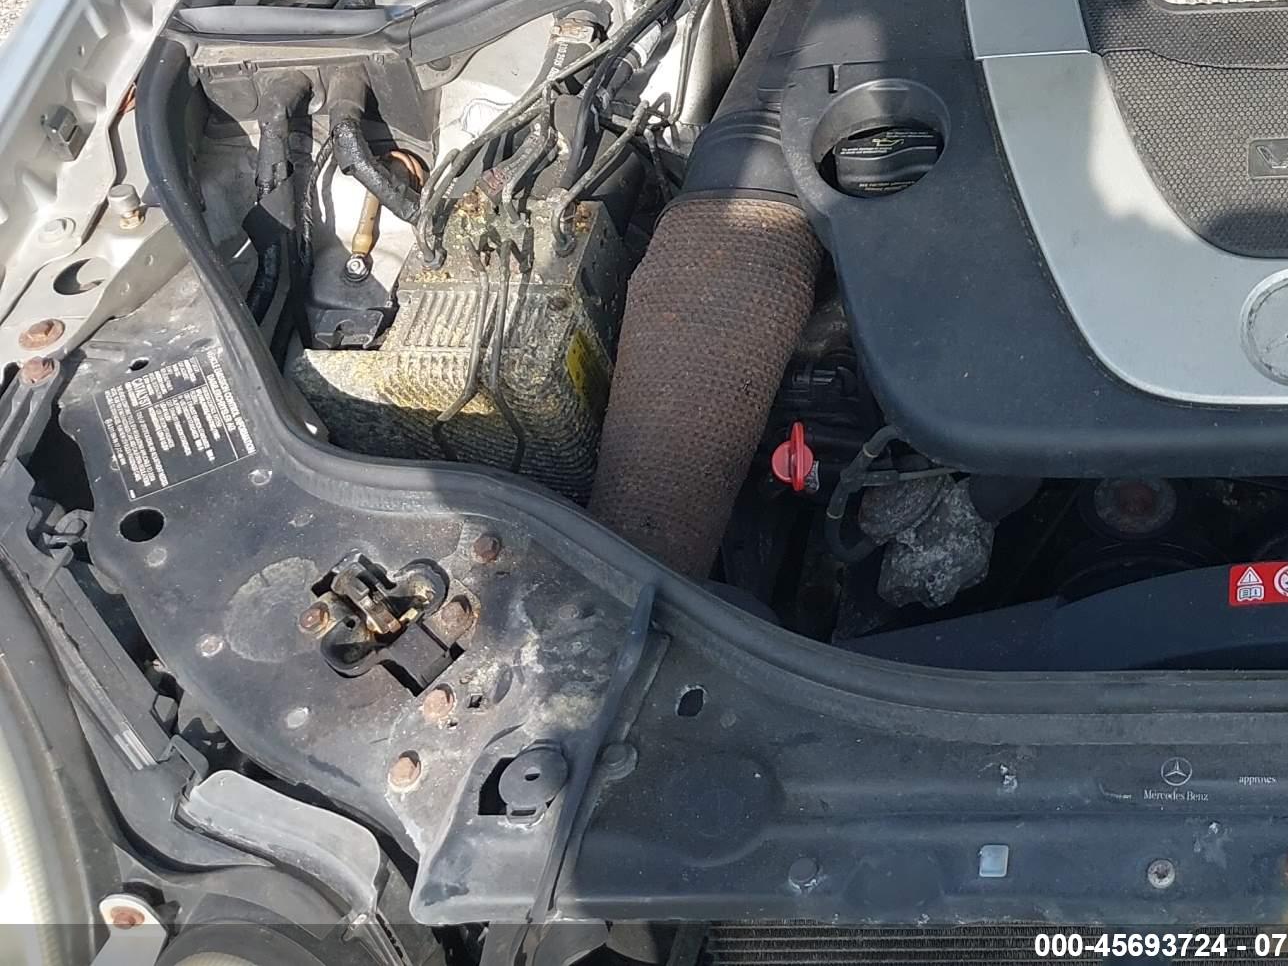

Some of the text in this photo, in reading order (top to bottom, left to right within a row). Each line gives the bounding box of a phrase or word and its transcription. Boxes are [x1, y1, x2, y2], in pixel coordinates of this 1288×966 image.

[129, 376, 151, 408] CATALYST
[223, 390, 240, 417] CONTROL
[236, 416, 256, 454] INFORMATION
[1238, 775, 1276, 785] approves
